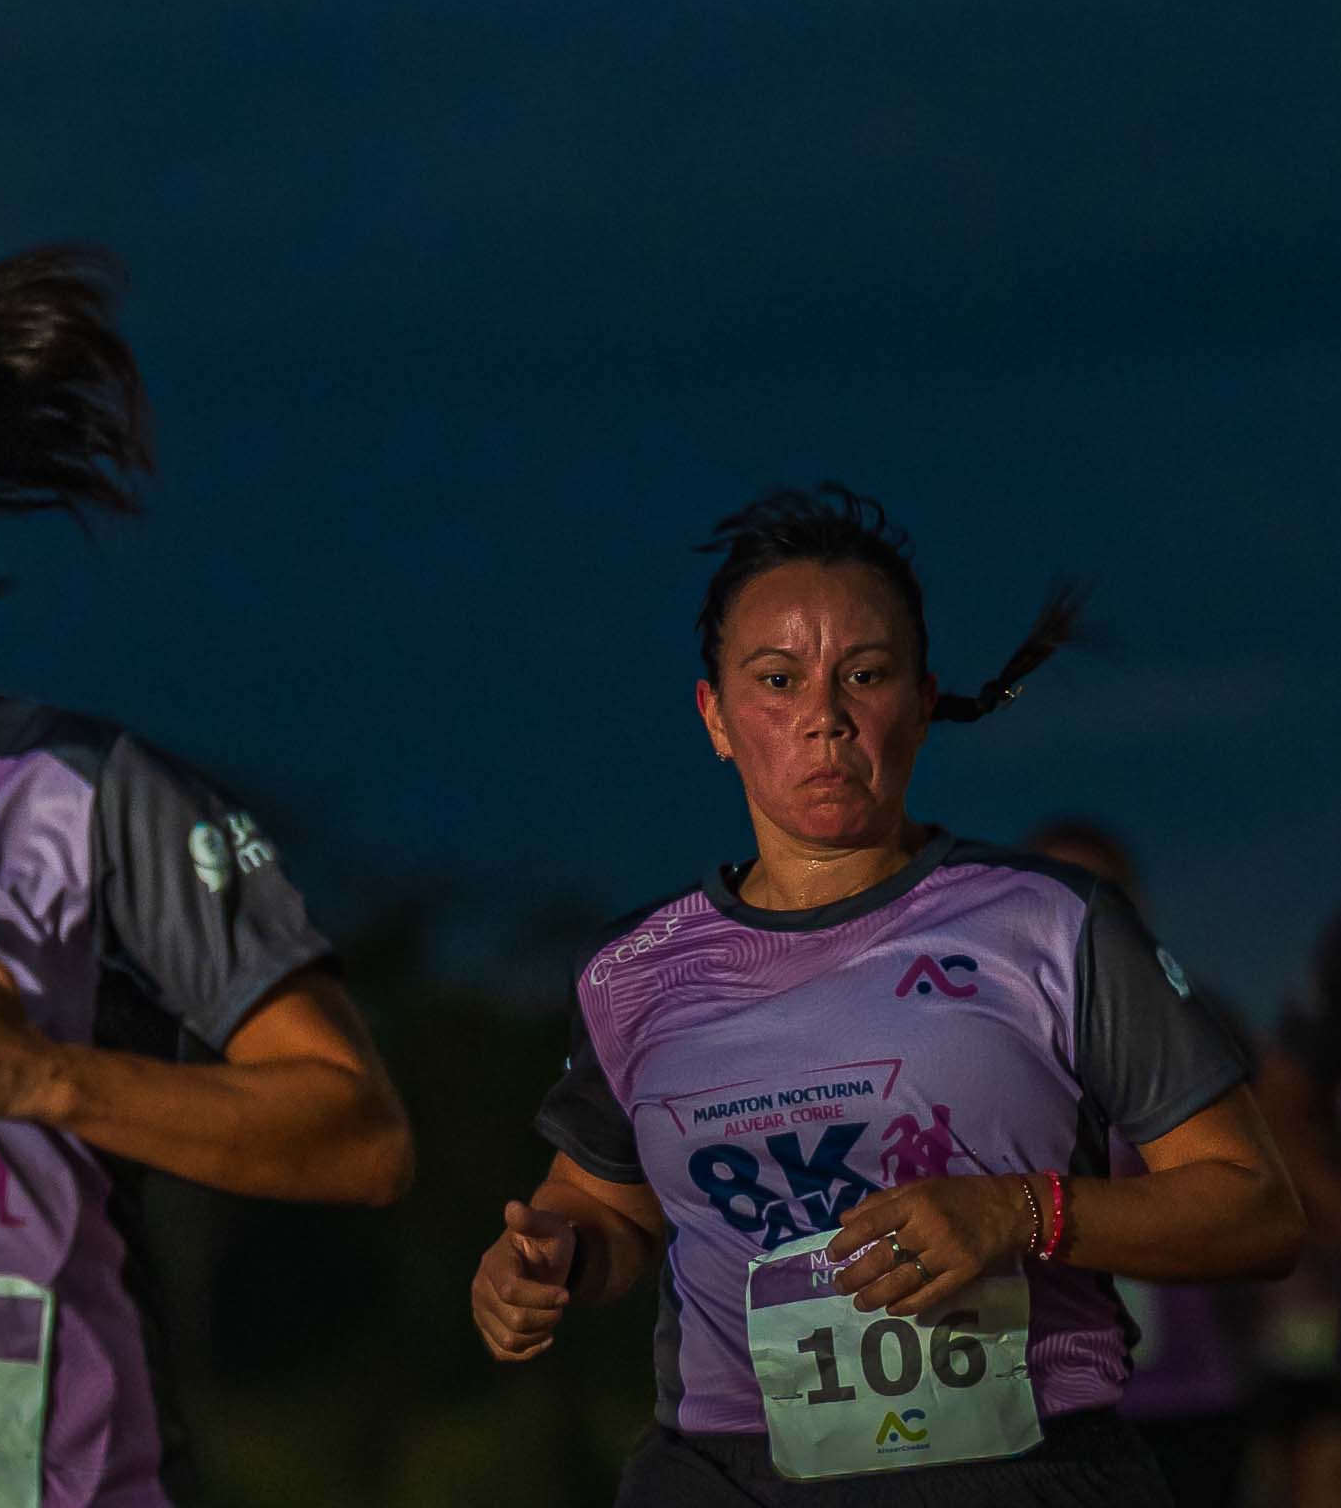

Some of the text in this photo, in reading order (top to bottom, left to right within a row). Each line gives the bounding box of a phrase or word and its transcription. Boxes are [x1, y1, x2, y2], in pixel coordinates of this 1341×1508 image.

[895, 954, 978, 997] AC
[693, 1080, 874, 1124] MARATON NOCTURNA
[724, 1103, 844, 1137] ALVEAR CORRE
[688, 1122, 885, 1233] 8K
[797, 1310, 987, 1405] 106
[875, 1409, 928, 1445] AC
